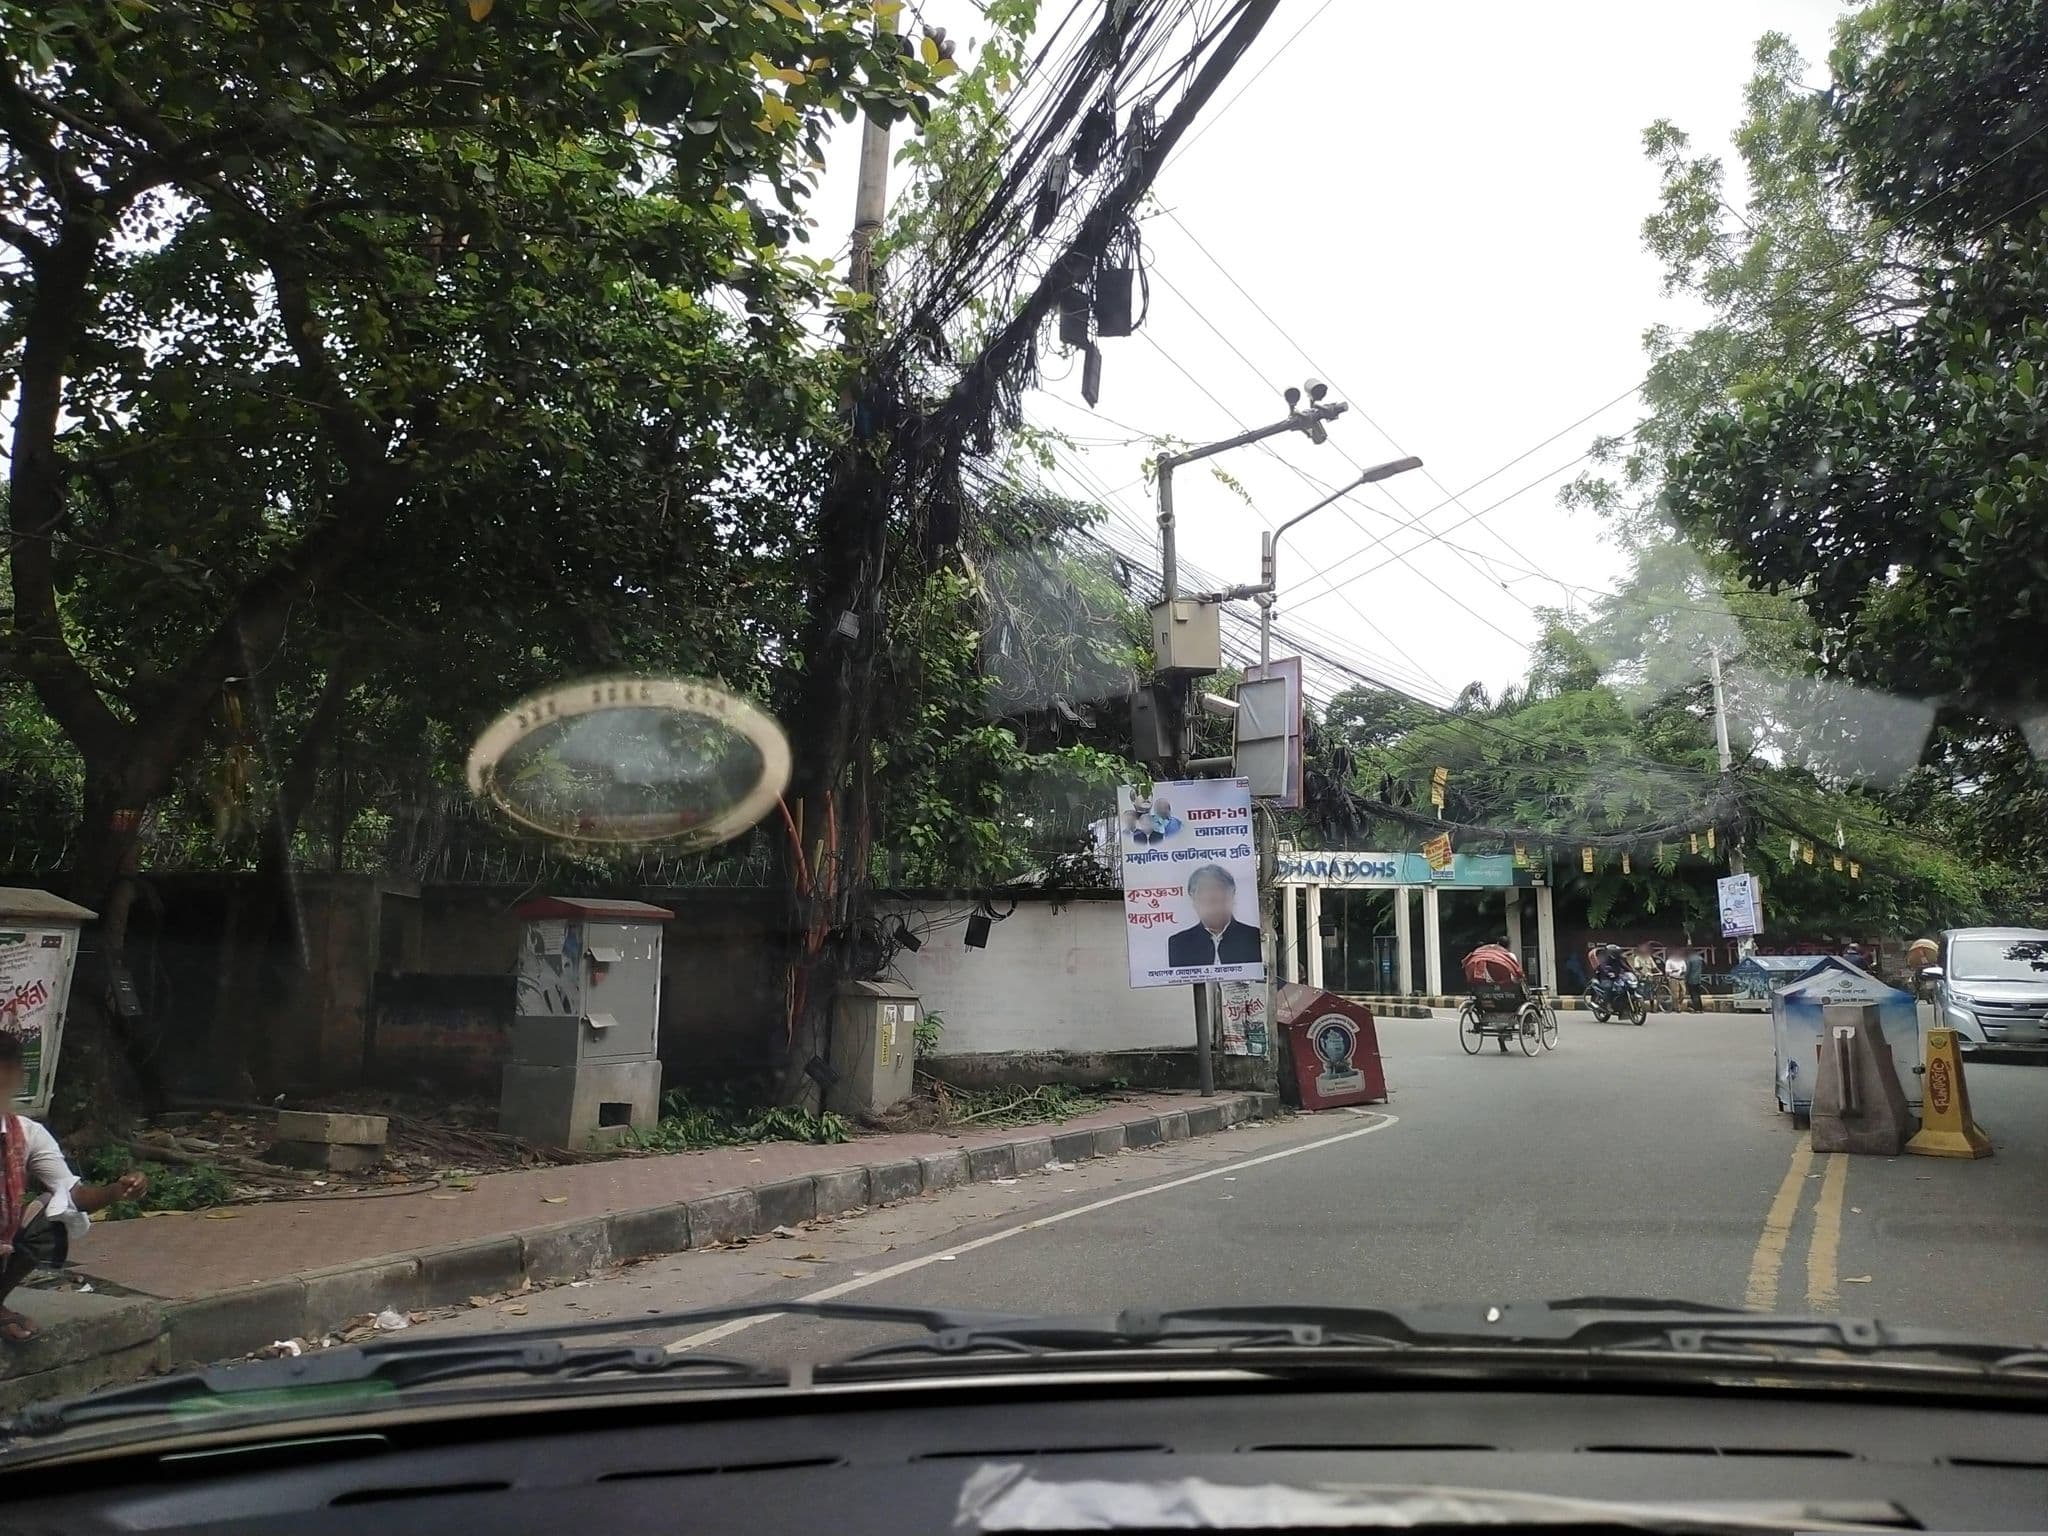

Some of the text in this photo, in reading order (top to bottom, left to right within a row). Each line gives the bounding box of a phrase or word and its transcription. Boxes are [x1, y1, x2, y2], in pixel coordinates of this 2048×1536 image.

[1187, 807, 1248, 821] ঢাকা-১৭
[1194, 824, 1249, 838] আসনের
[1125, 843, 1251, 865] সম্মানিত ভোটারদের প্রতি
[1343, 860, 1397, 878] DOHS
[1127, 886, 1184, 903] কৃতজ্ঞতা
[1128, 911, 1179, 929] ধন্যবাদ
